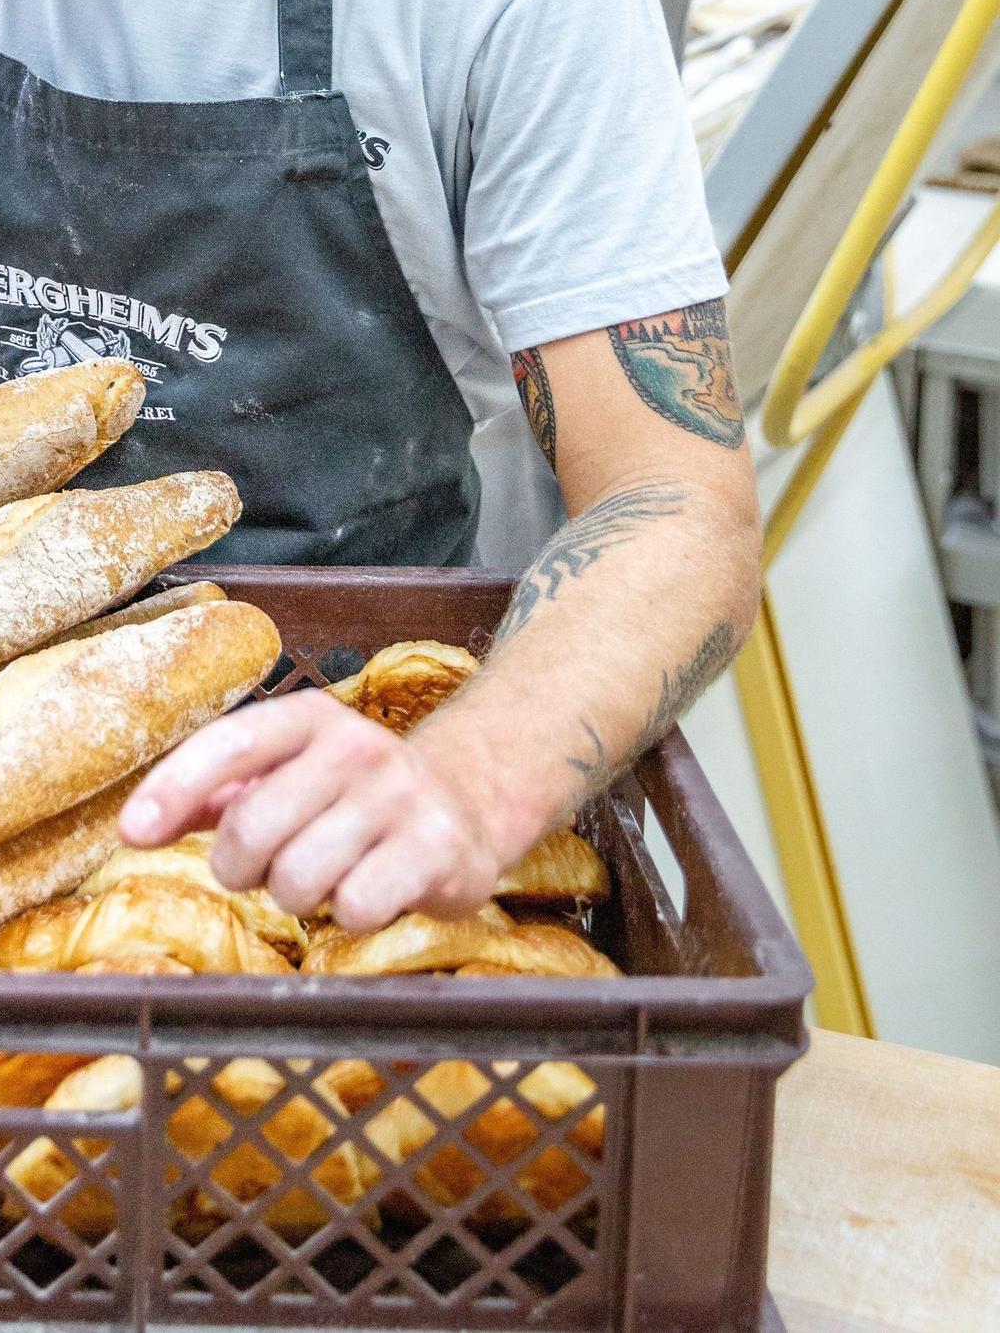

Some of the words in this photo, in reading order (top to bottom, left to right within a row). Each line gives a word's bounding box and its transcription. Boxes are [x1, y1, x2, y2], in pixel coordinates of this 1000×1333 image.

[357, 130, 391, 170] 'S
[10, 334, 33, 347] seit
[133, 362, 159, 377] 985
